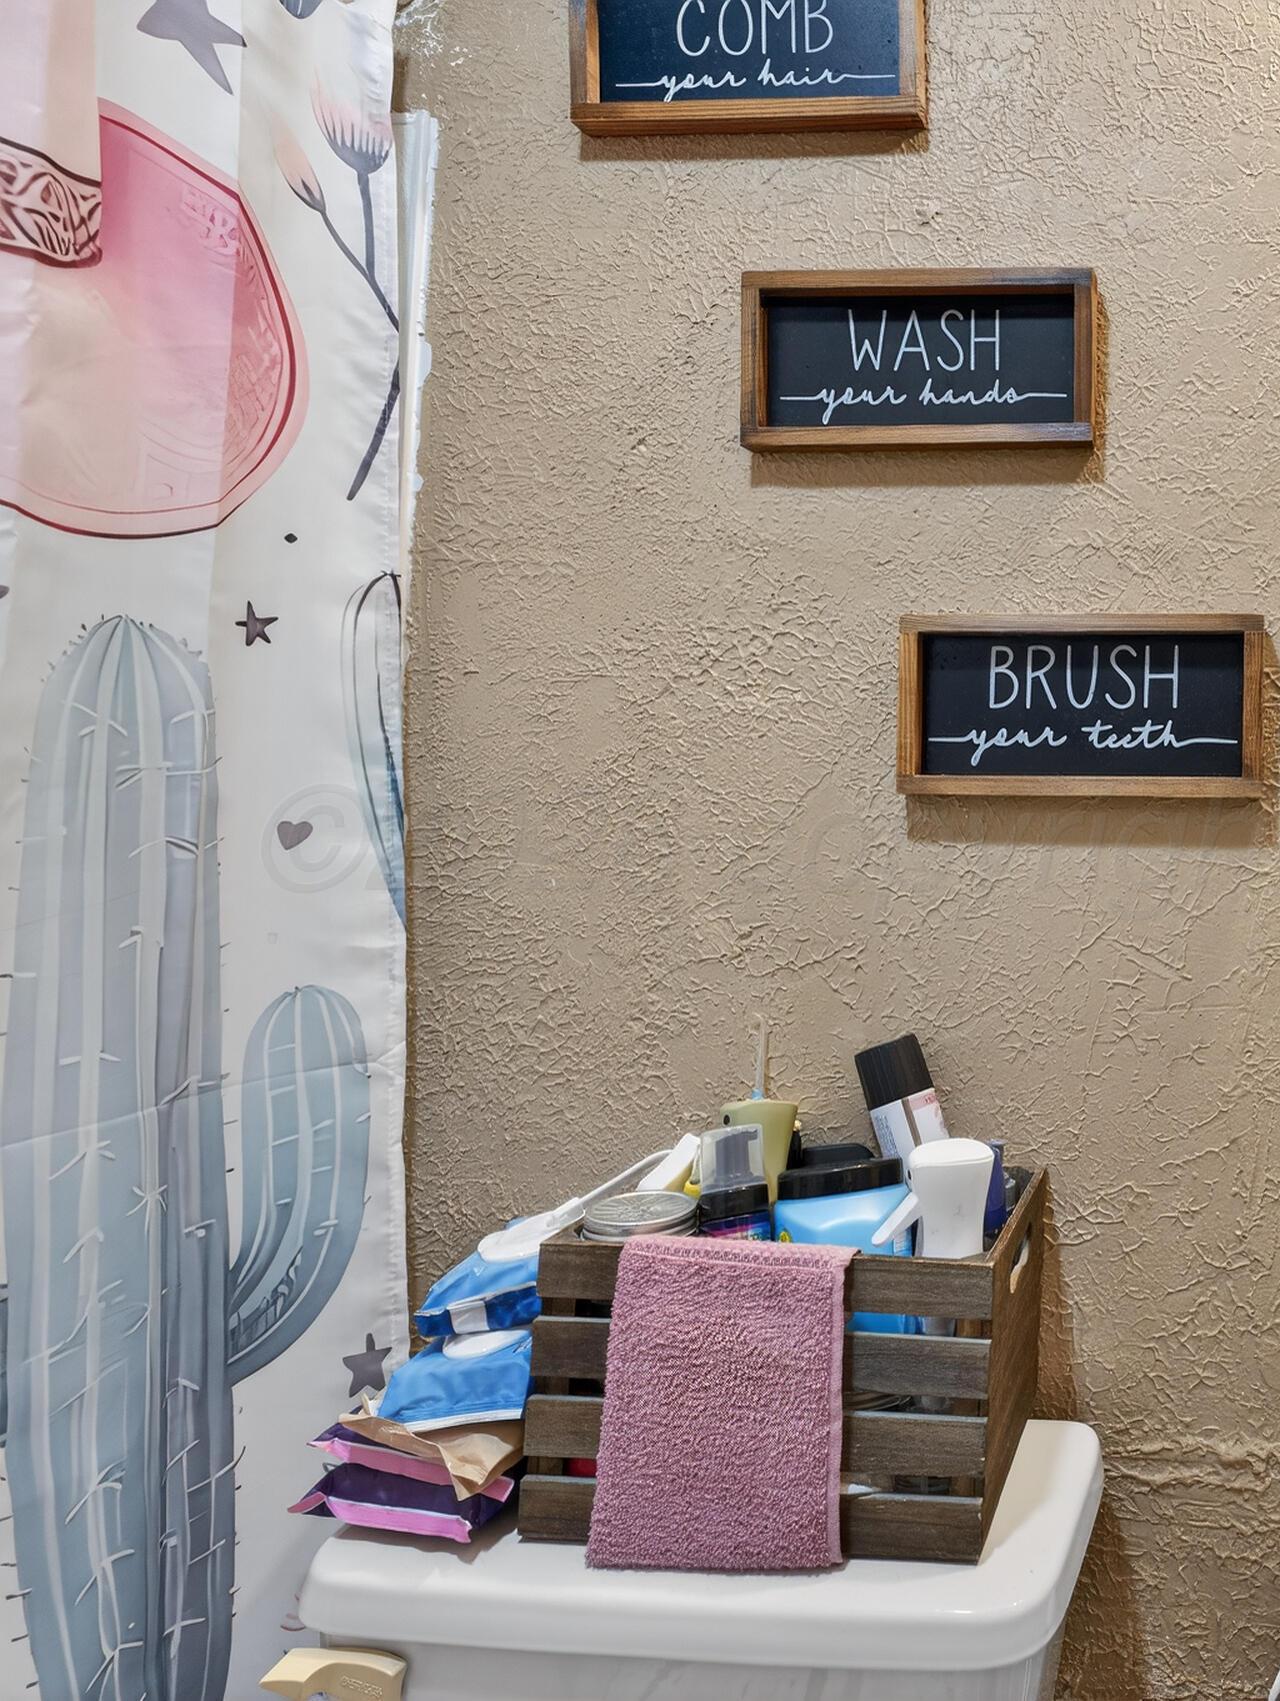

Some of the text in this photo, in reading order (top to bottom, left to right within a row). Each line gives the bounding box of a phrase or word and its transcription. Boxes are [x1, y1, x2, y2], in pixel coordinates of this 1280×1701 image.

[675, 0, 835, 57] COMB
[640, 57, 868, 101] your hair
[847, 309, 1001, 372] WASH
[802, 377, 1040, 425] your hands
[988, 644, 1180, 711] BRUSH
[950, 719, 1205, 767] your teeth
